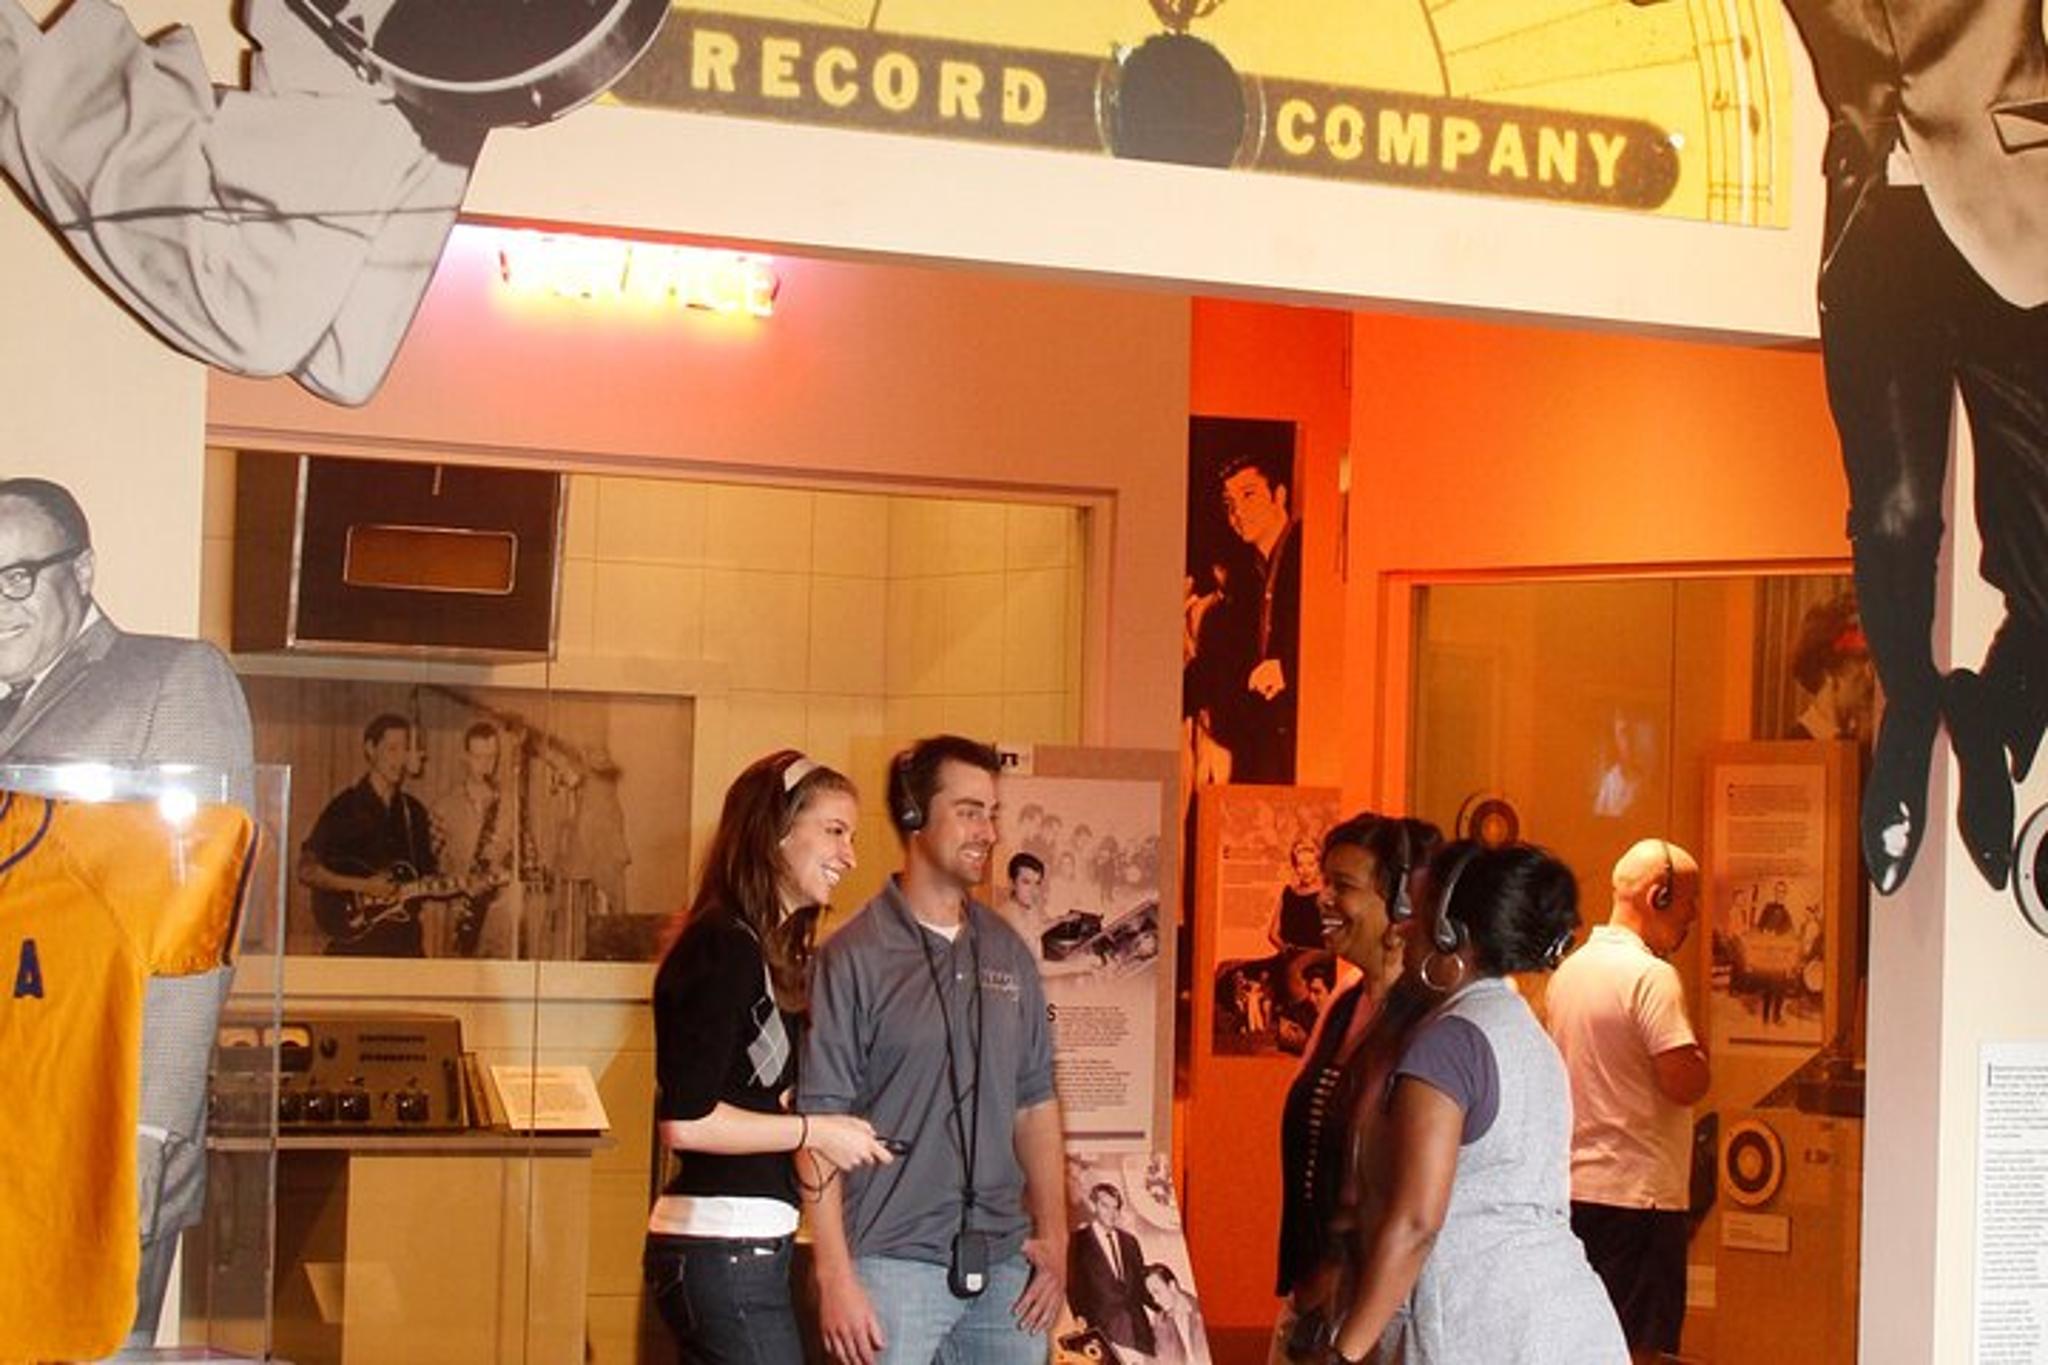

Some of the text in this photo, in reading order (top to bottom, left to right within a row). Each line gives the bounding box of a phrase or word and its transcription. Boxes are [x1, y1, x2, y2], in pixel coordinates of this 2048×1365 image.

[690, 29, 1627, 188] RECORD COMPANY
[13, 938, 45, 999] A
